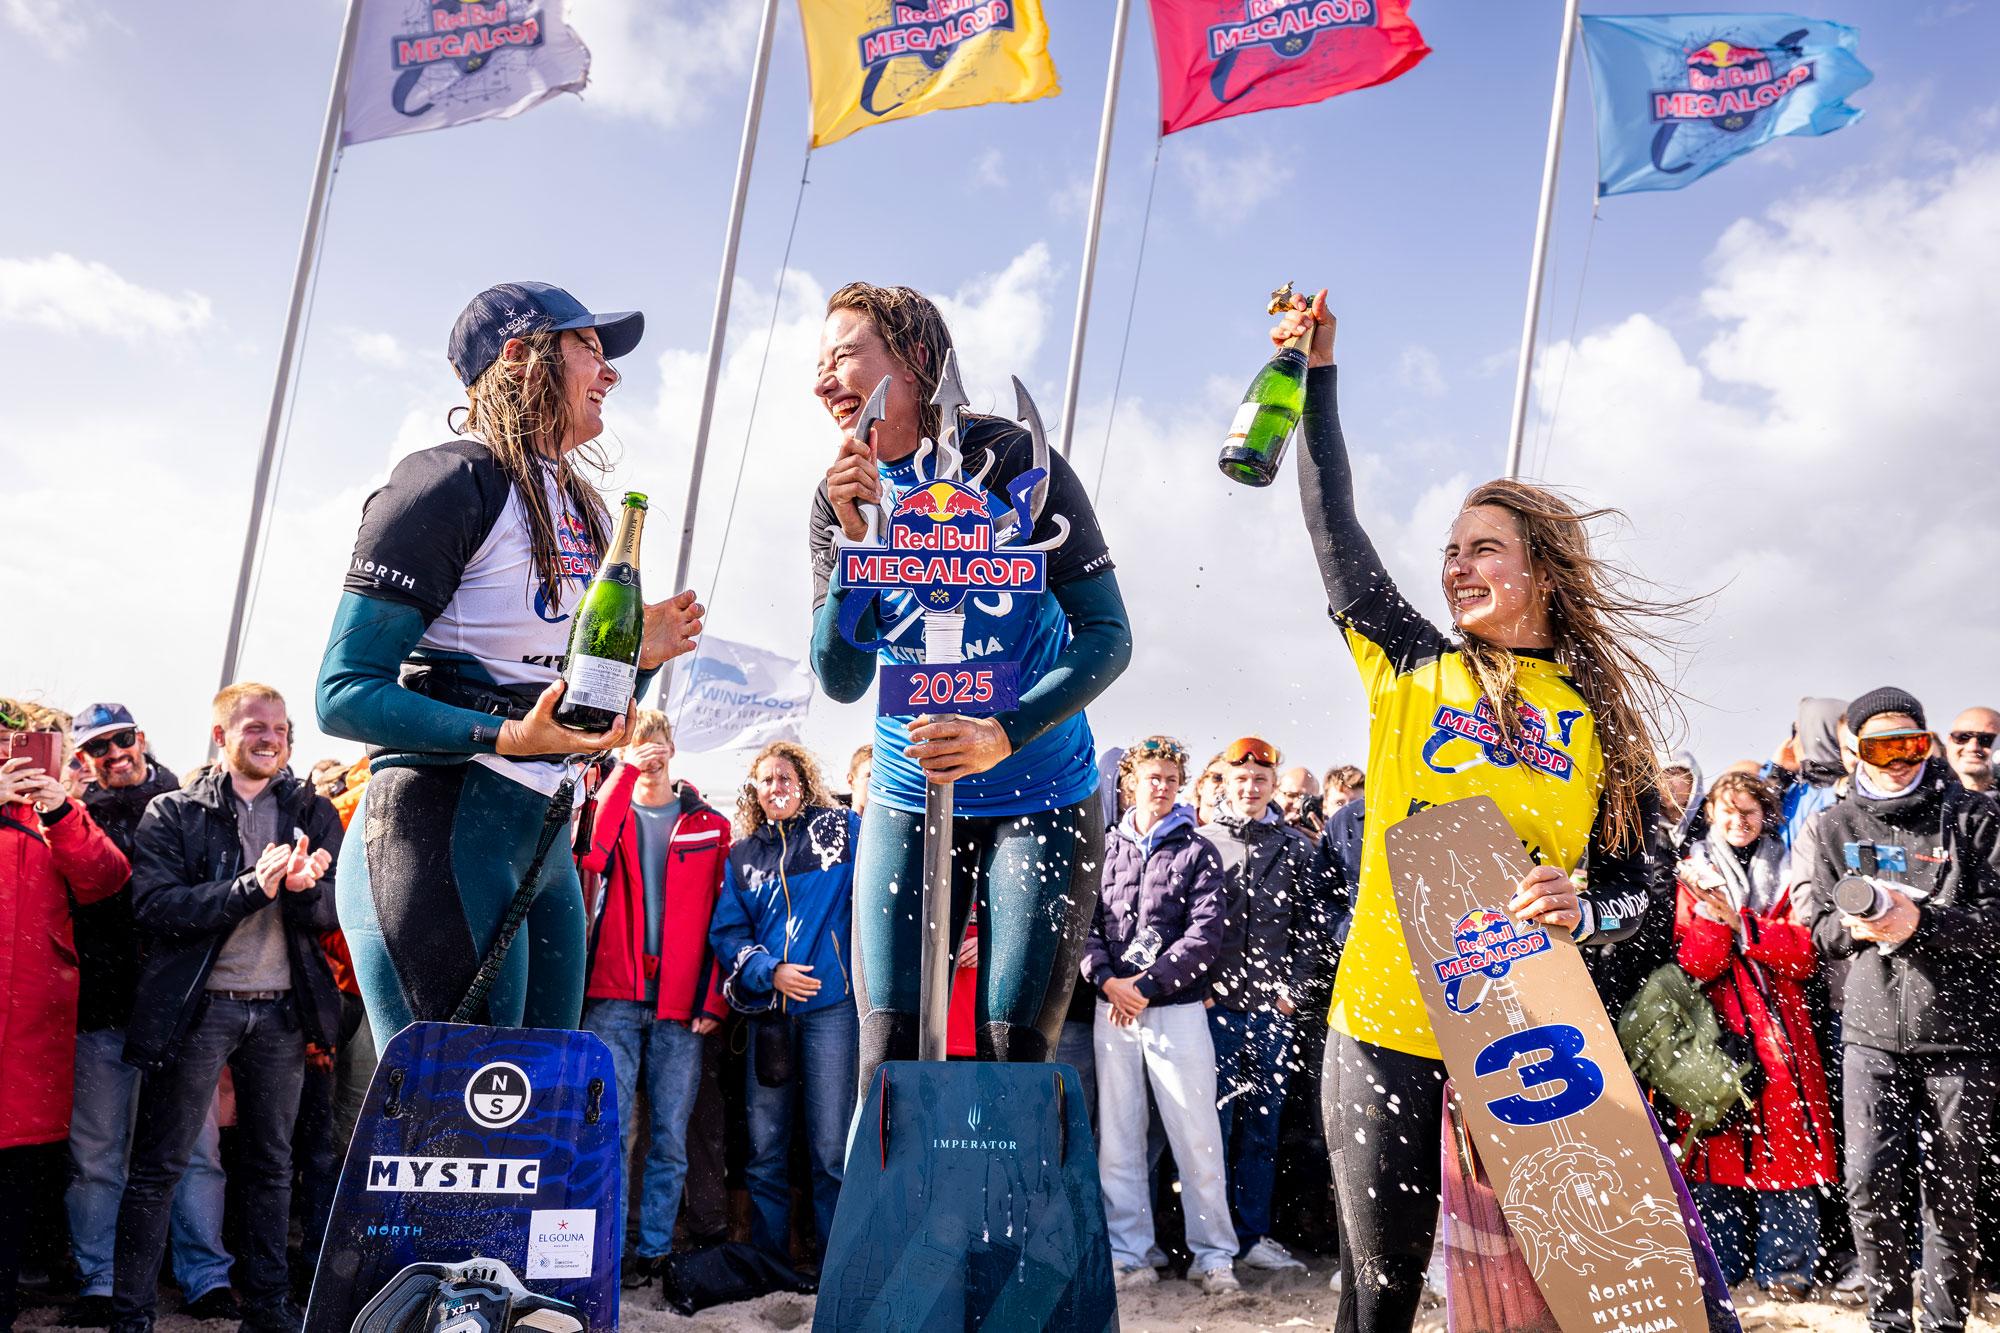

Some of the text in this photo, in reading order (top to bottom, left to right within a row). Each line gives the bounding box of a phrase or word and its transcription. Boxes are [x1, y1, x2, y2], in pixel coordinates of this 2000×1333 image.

[432, 0, 507, 31] Red Bull
[896, 0, 938, 24] Red
[399, 18, 540, 65] MEGALOOP
[864, 1, 1009, 62] MEGALOOP
[1213, 1, 1370, 55] MEGALOOP
[1728, 60, 1771, 87] Bull
[498, 327, 508, 336] EL
[506, 308, 538, 330] GOUNA
[886, 464, 915, 477] MYSTI
[627, 519, 638, 554] PANNIER
[893, 524, 989, 551] Red Bull
[354, 557, 415, 589] NORTH
[847, 555, 1036, 587] MEGALOOP
[908, 671, 994, 705] 2025
[1457, 925, 1514, 955] Red Bull
[1439, 935, 1545, 979] MEGALOOP
[492, 1074, 508, 1091] N
[1474, 1023, 1605, 1126] 3
[489, 1098, 504, 1115] S
[933, 1139, 1017, 1150] IMPERATOR
[369, 1160, 538, 1189] MYSTIC
[367, 1225, 422, 1237] NORTH
[538, 1233, 585, 1242] EL GOUNA
[1588, 1275, 1656, 1303] NORTH
[450, 1301, 480, 1316] FLEX
[1592, 1295, 1667, 1325] MYSTIC
